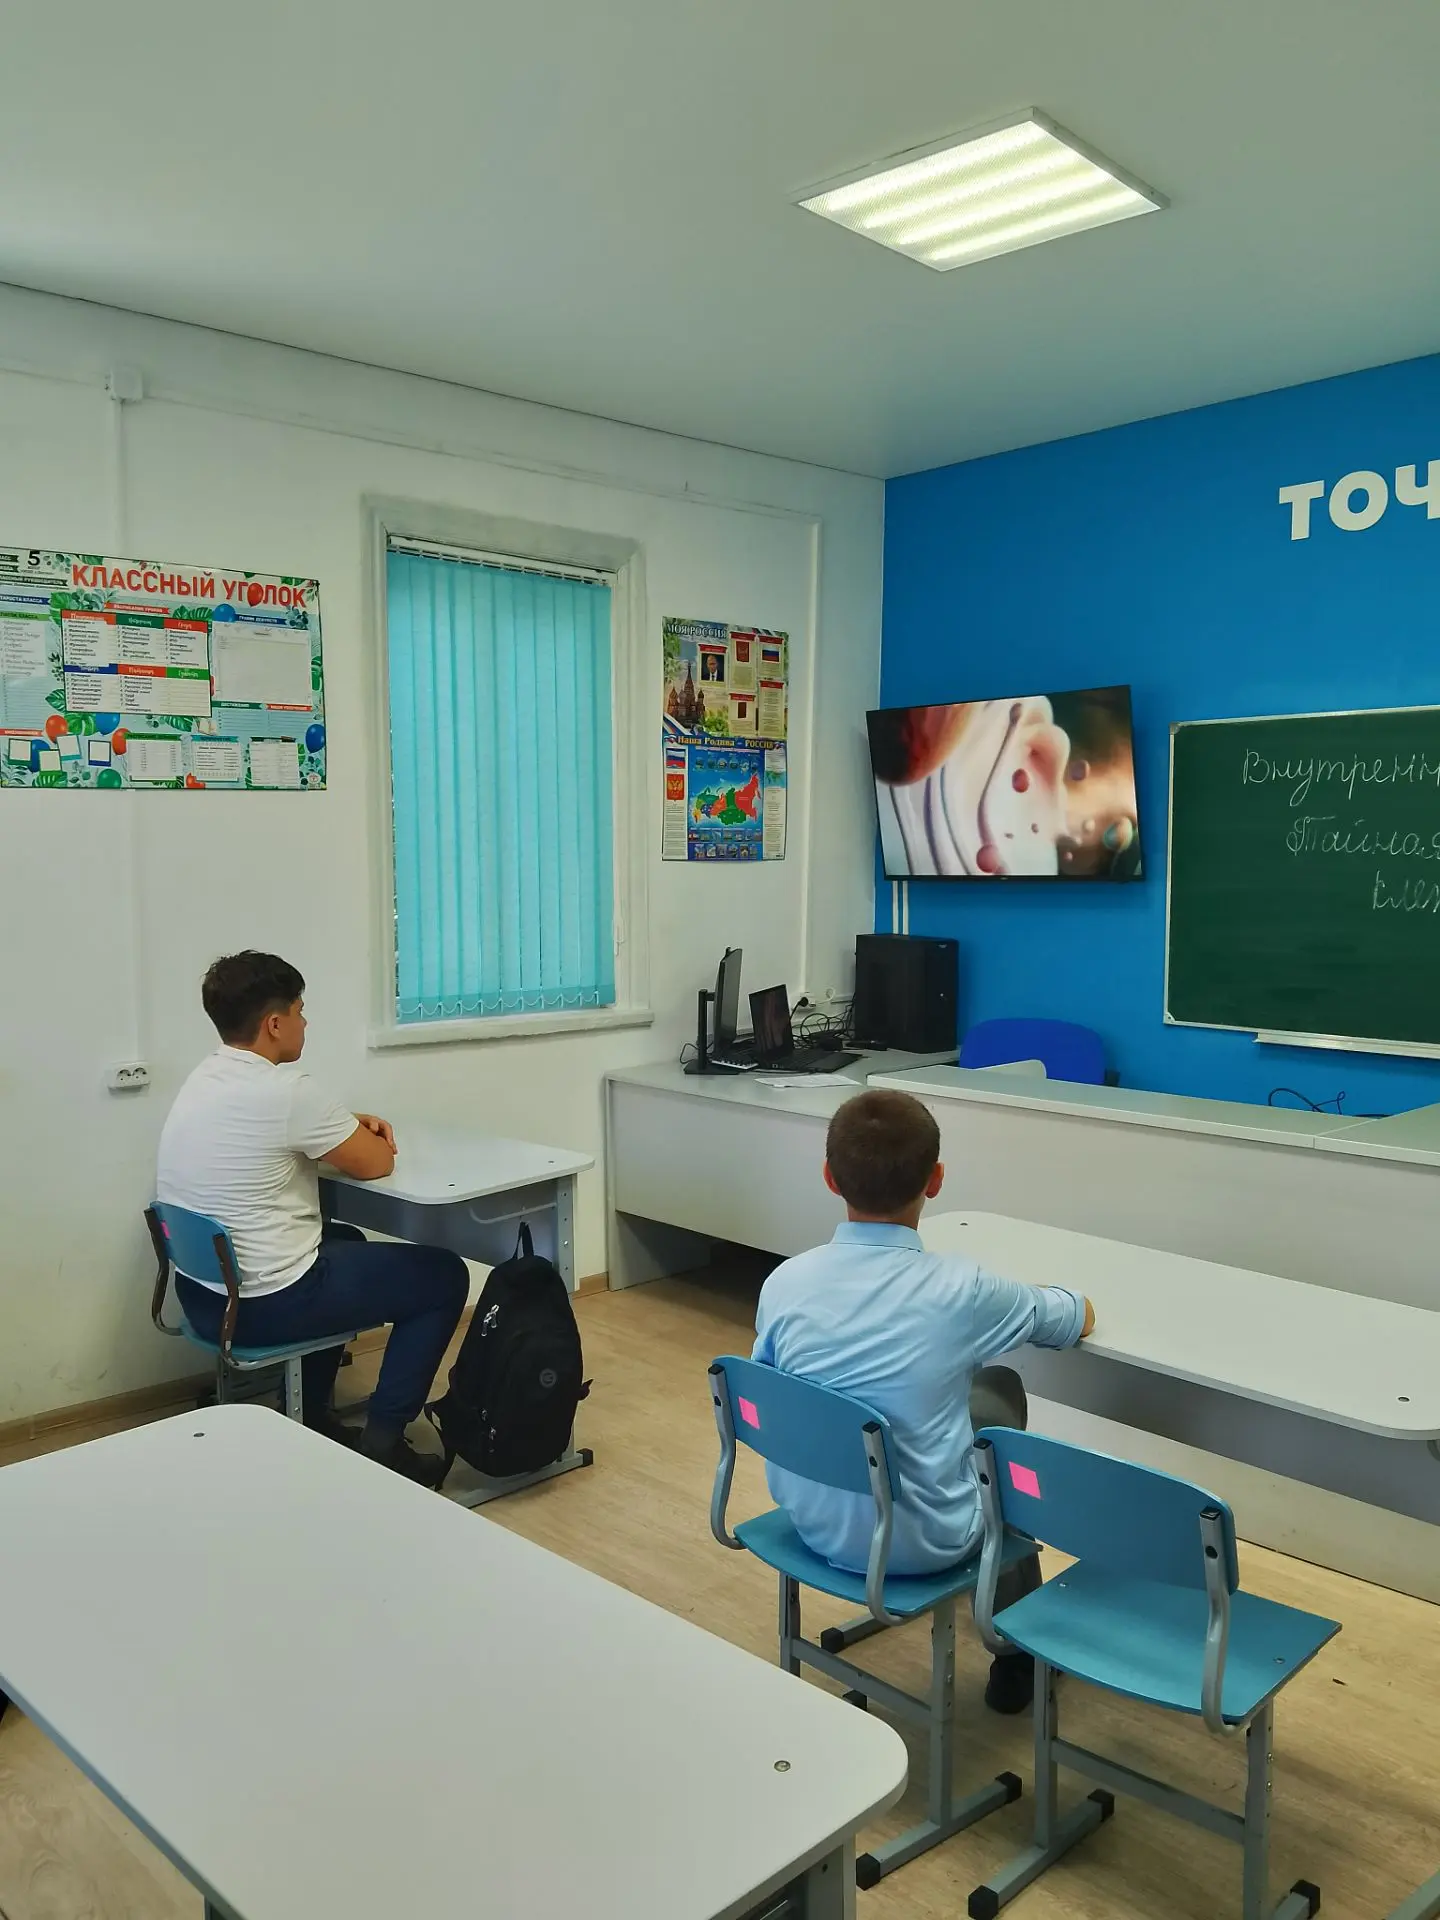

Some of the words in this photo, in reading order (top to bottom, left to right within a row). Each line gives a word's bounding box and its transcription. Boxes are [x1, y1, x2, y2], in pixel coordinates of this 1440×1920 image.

[27, 550, 41, 566] 5
[72, 563, 215, 599] КЛАССНЫЙ
[223, 578, 306, 608] УГОЛОК
[688, 625, 727, 639] РОССИЯ
[678, 735, 702, 746] Наша
[704, 737, 735, 748] Родина
[745, 739, 774, 749] РОССИЯ
